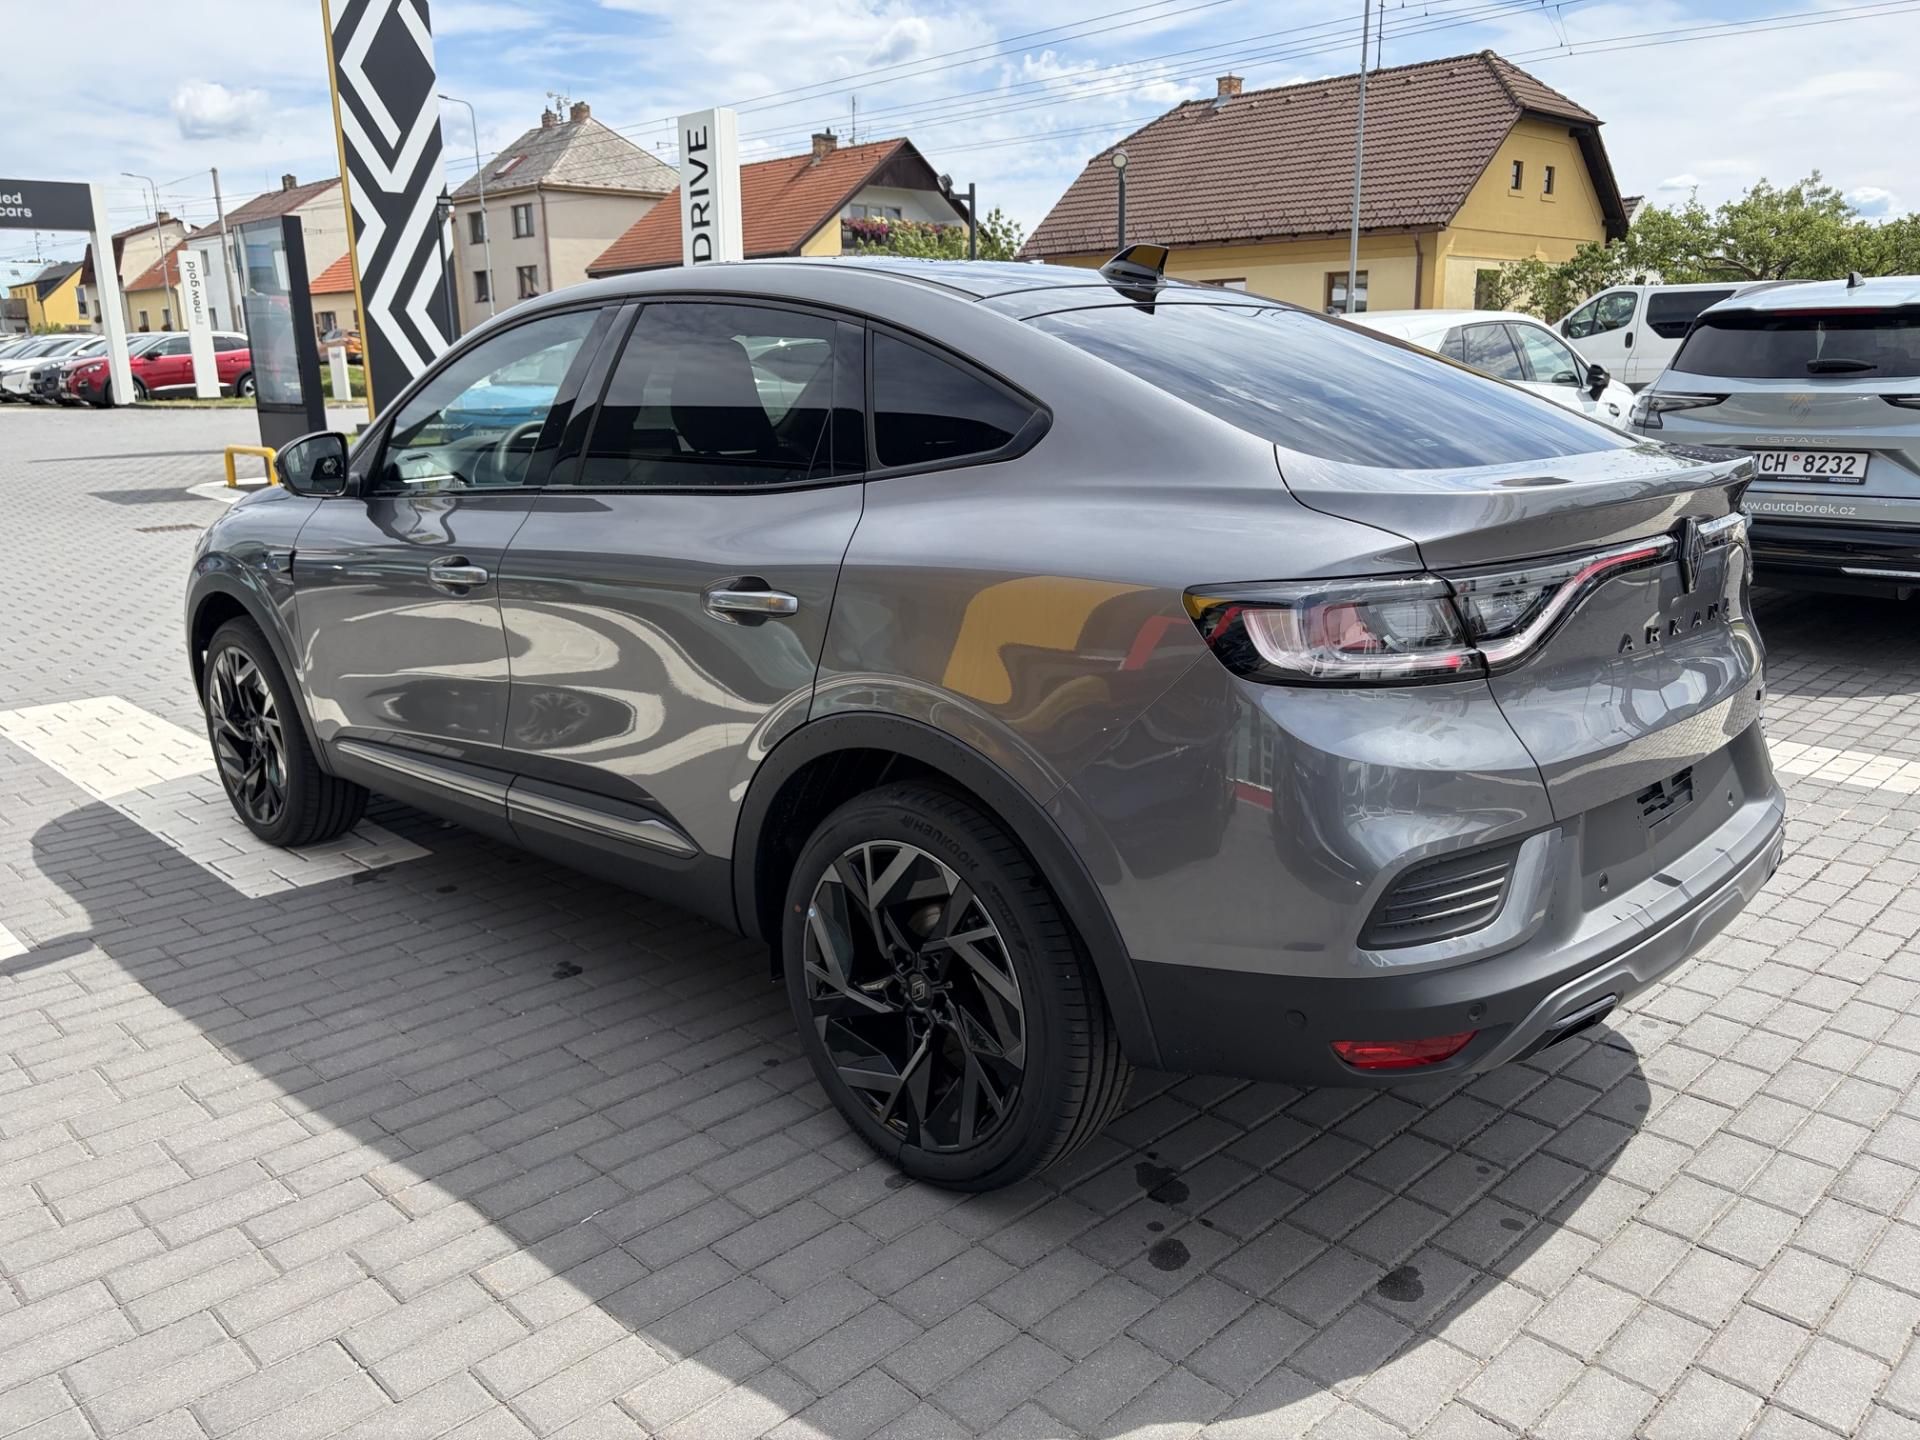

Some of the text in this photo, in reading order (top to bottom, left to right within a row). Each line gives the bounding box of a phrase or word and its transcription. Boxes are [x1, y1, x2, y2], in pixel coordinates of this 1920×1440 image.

[687, 125, 712, 265] DRIVE
[185, 261, 200, 288] gold
[1803, 454, 1856, 475] 8232
